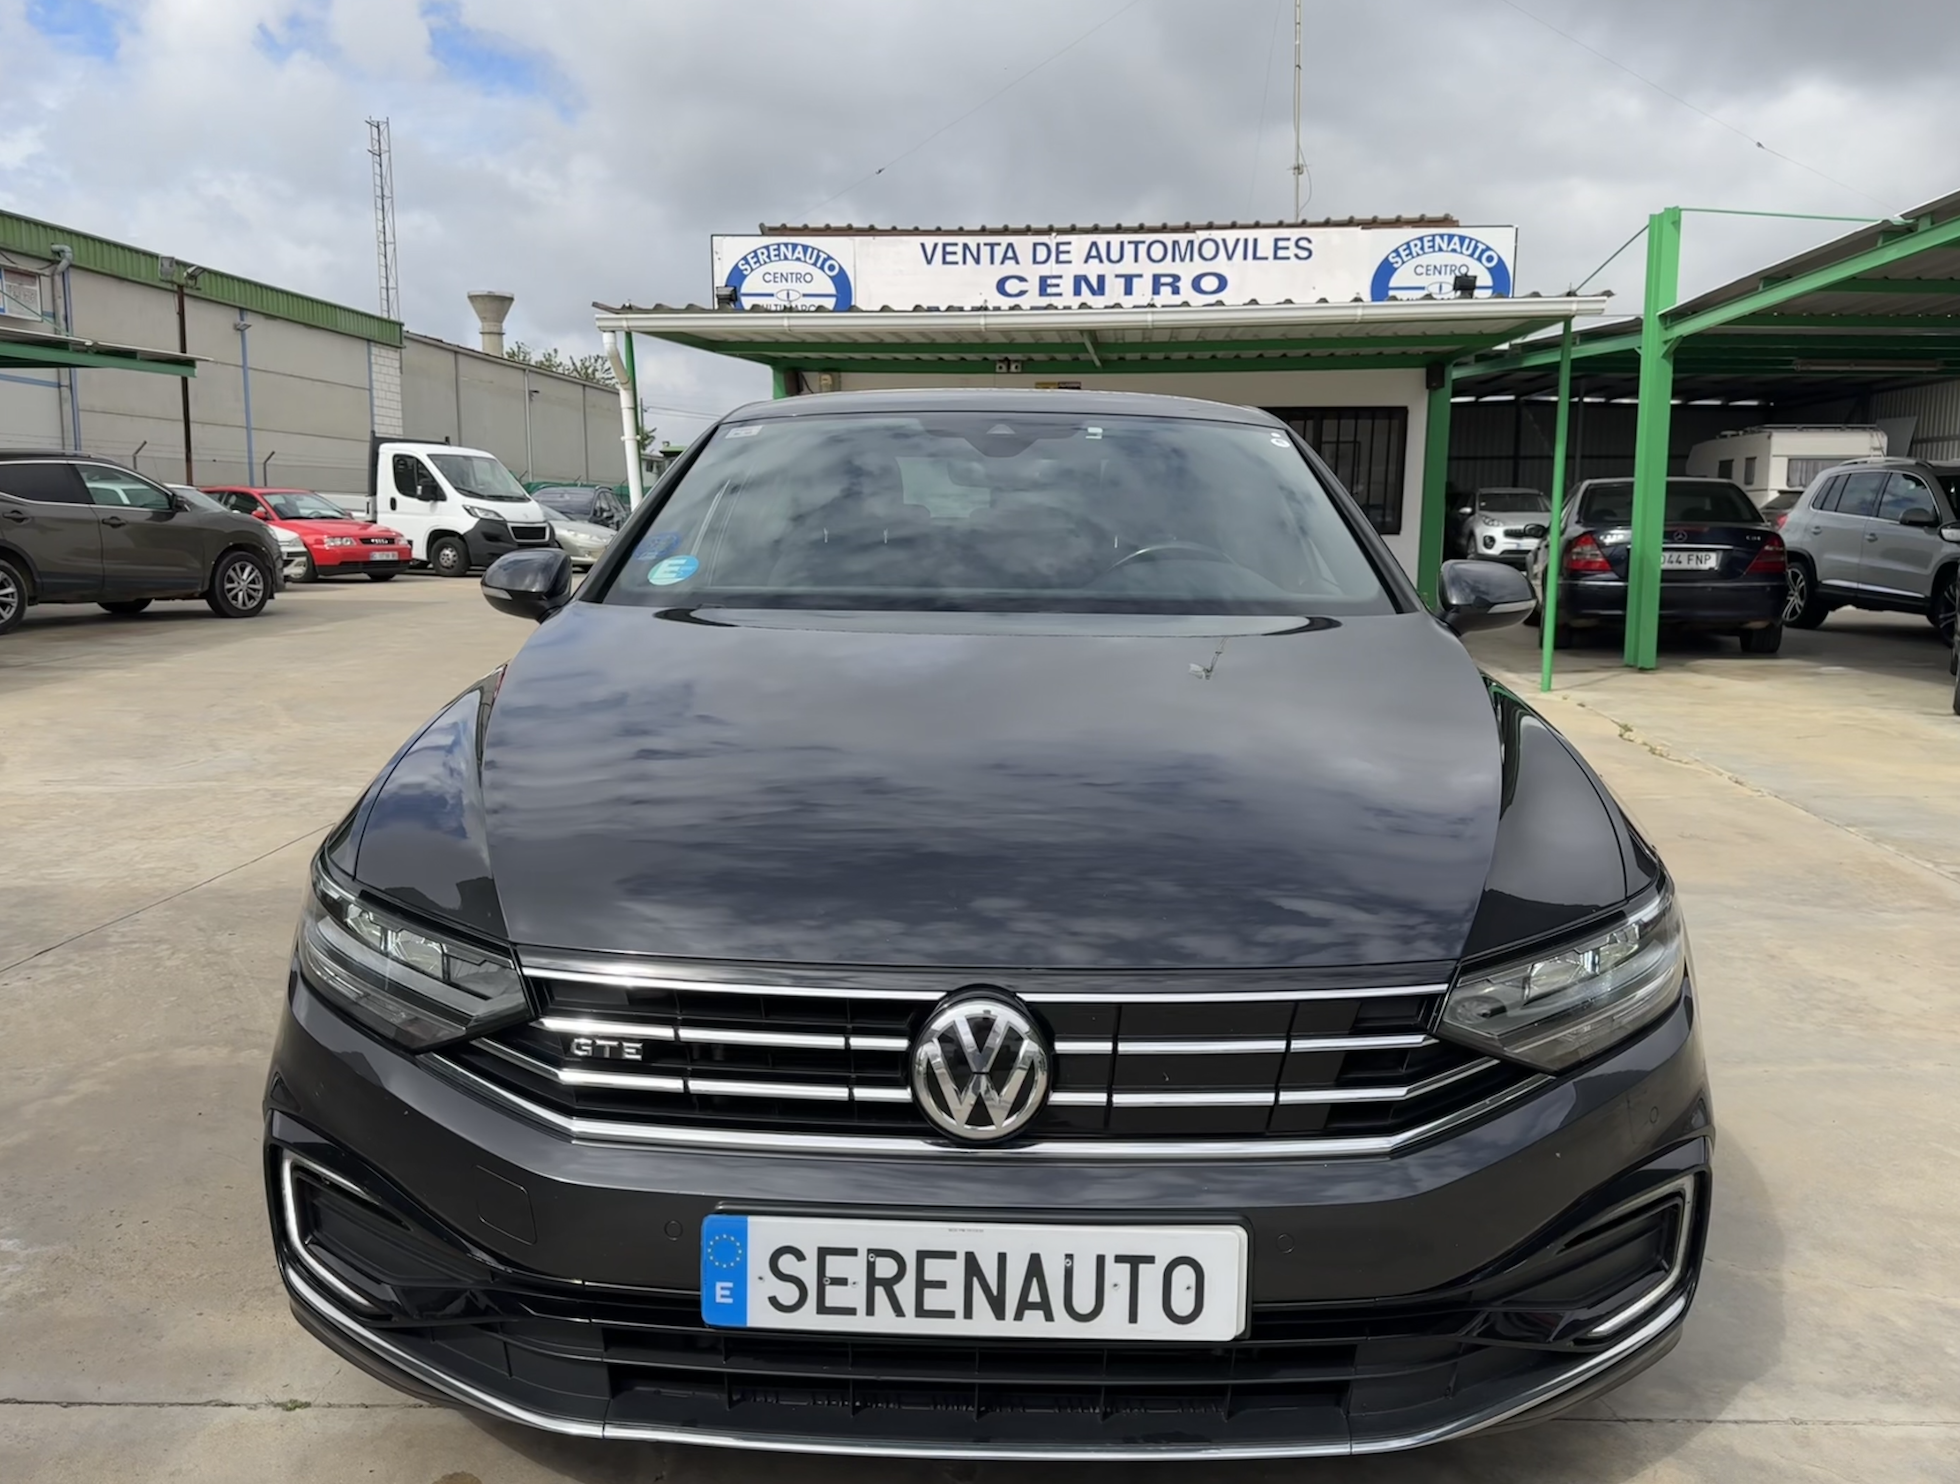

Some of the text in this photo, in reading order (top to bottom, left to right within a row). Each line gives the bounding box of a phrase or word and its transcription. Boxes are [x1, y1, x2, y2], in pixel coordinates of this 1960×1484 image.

[738, 244, 840, 276] SERENAUTO
[920, 237, 1313, 265] VENTA DE AUTOMOVILES
[1388, 235, 1499, 268] SERENAUTO
[762, 271, 814, 284] CENTRO
[1414, 263, 1470, 276] CENTRO
[996, 271, 1228, 298] CENTRO
[1687, 553, 1712, 566] FNP
[570, 1038, 643, 1061] GTE
[715, 1281, 734, 1304] E
[766, 1244, 1206, 1326] SERENAUTO
